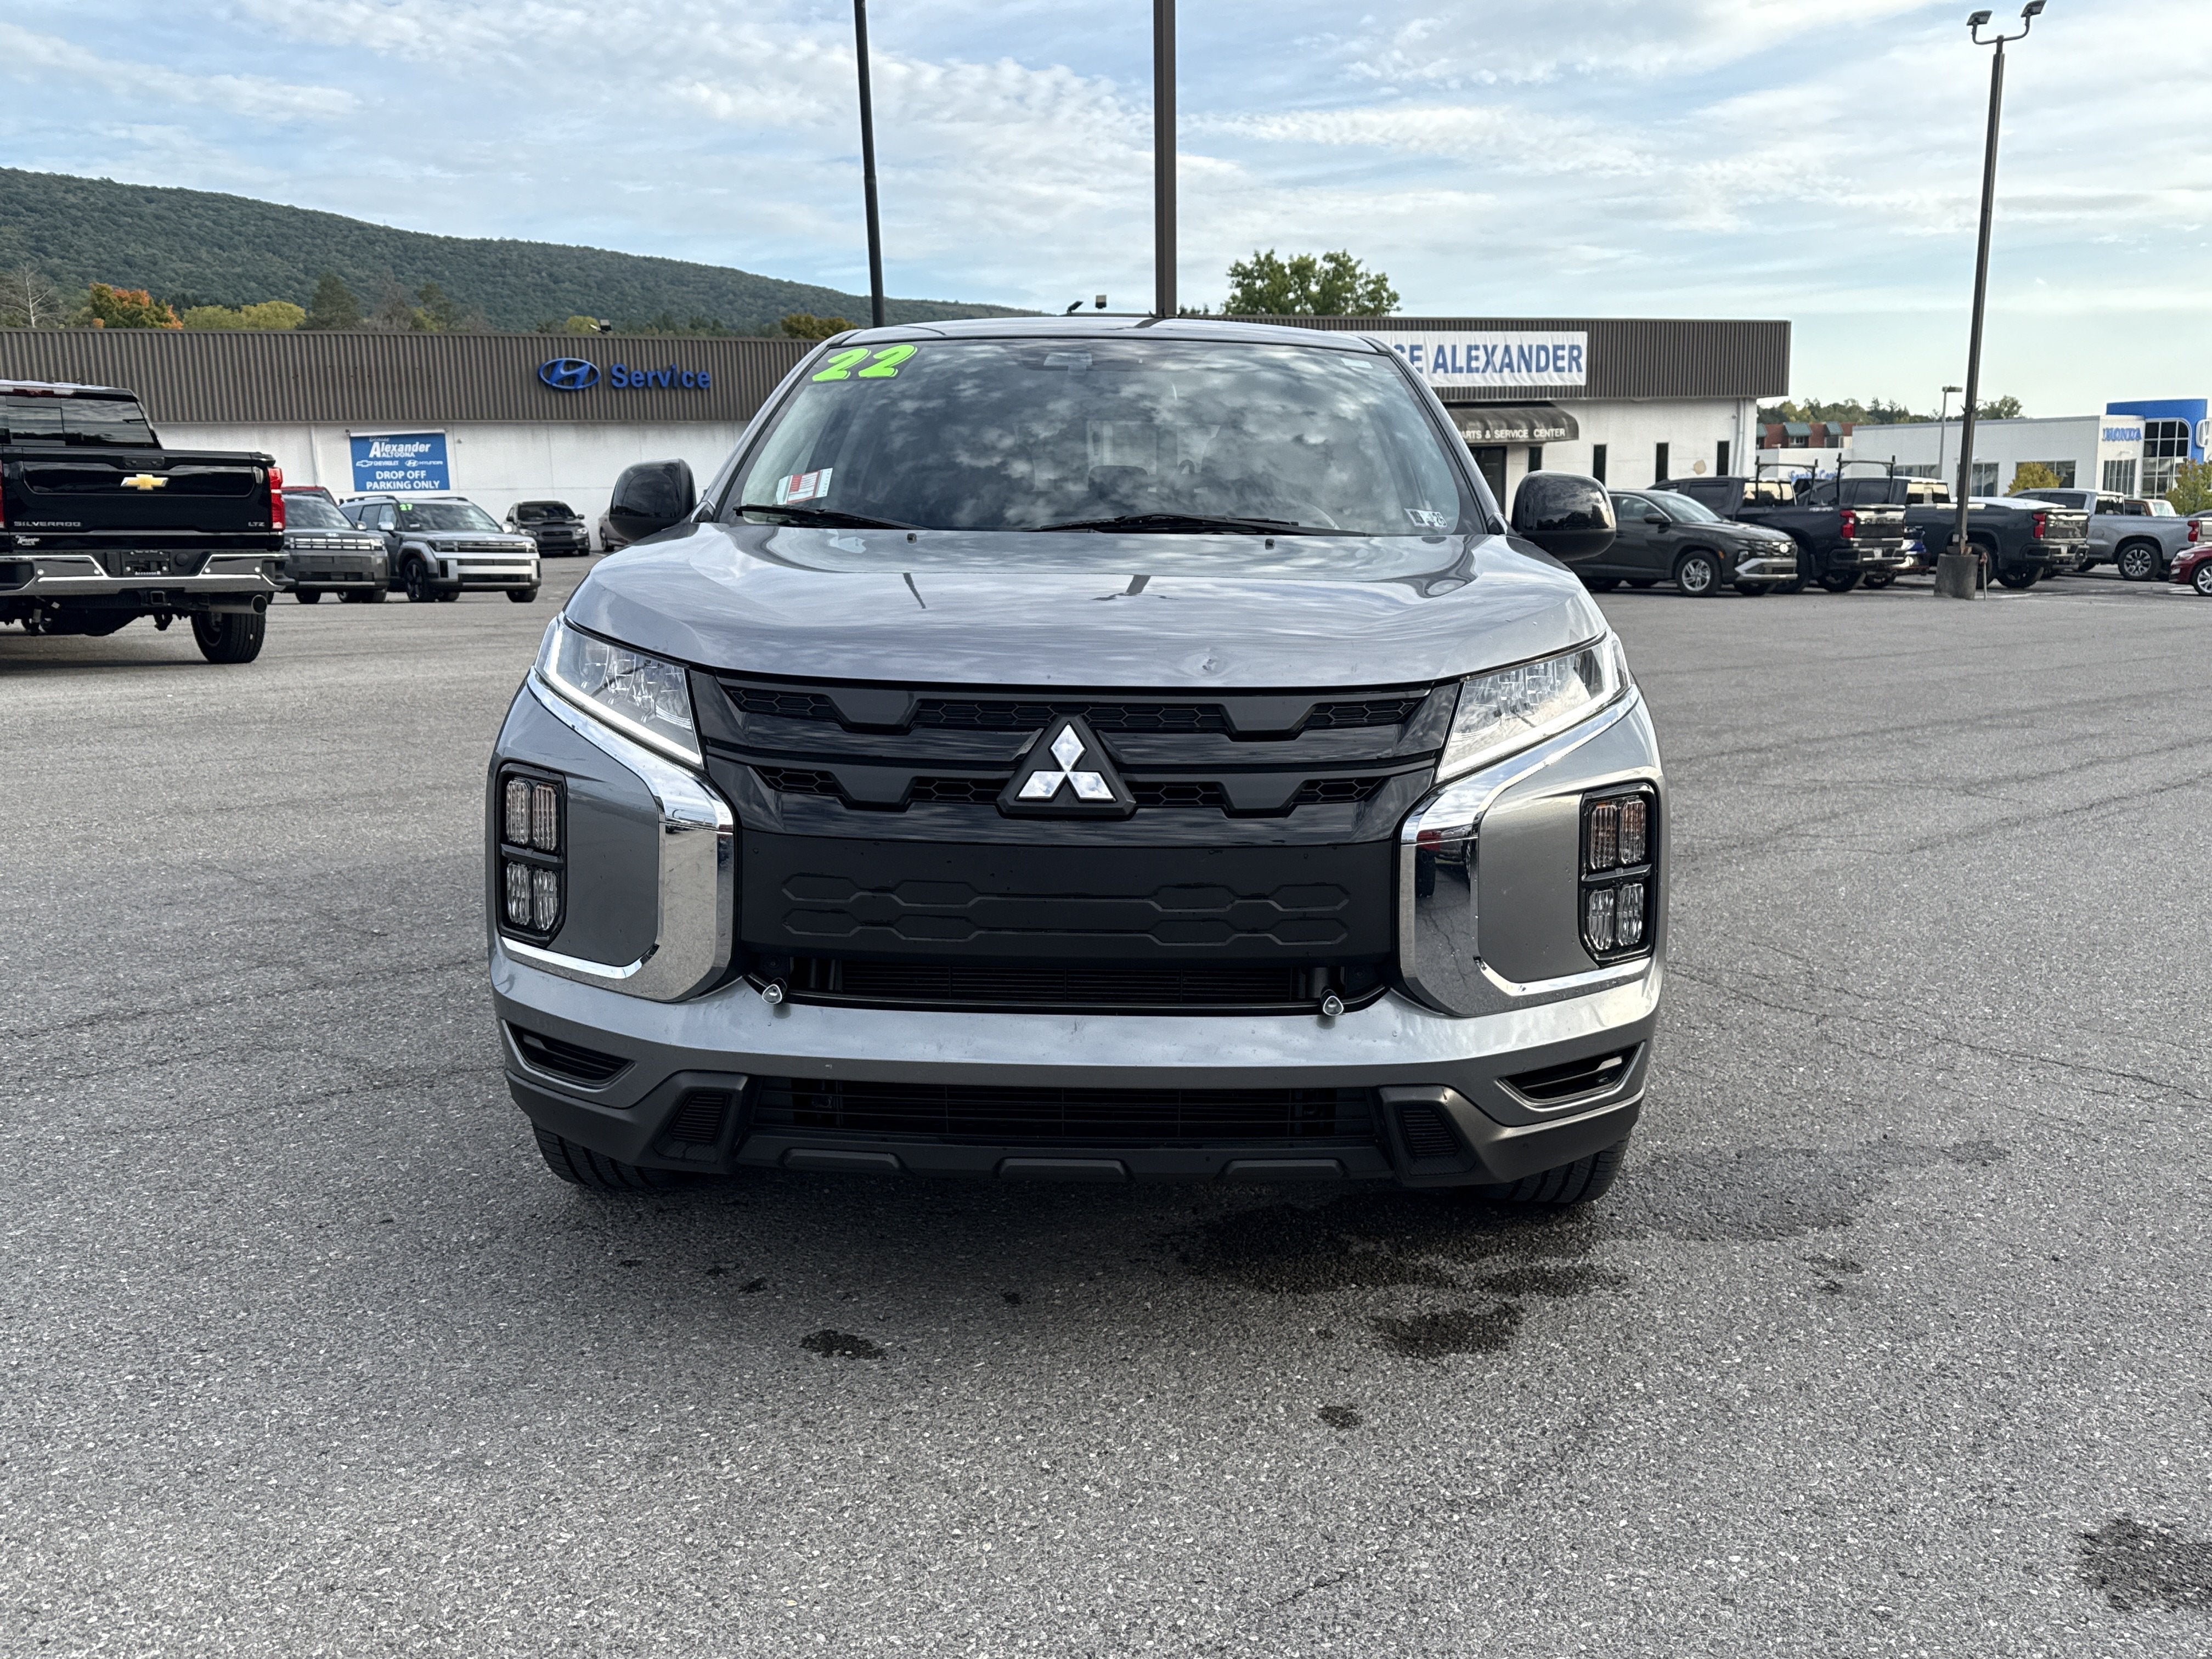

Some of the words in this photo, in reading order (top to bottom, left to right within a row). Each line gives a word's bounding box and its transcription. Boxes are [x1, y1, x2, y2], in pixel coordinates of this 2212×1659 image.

[812, 345, 917, 381] 22
[1432, 345, 1583, 374] ALEXANDER
[611, 363, 711, 388] Service
[1459, 430, 1482, 439] ARTS
[1485, 430, 1491, 439] &
[1494, 429, 1529, 439] SERVICE
[1533, 428, 1566, 437] CENTER
[2102, 427, 2142, 441] HONDA
[369, 442, 431, 458] Alexander
[376, 471, 404, 479] DROP
[407, 470, 426, 479] OFF
[366, 481, 411, 490] PARKING
[413, 481, 440, 489] ONLY
